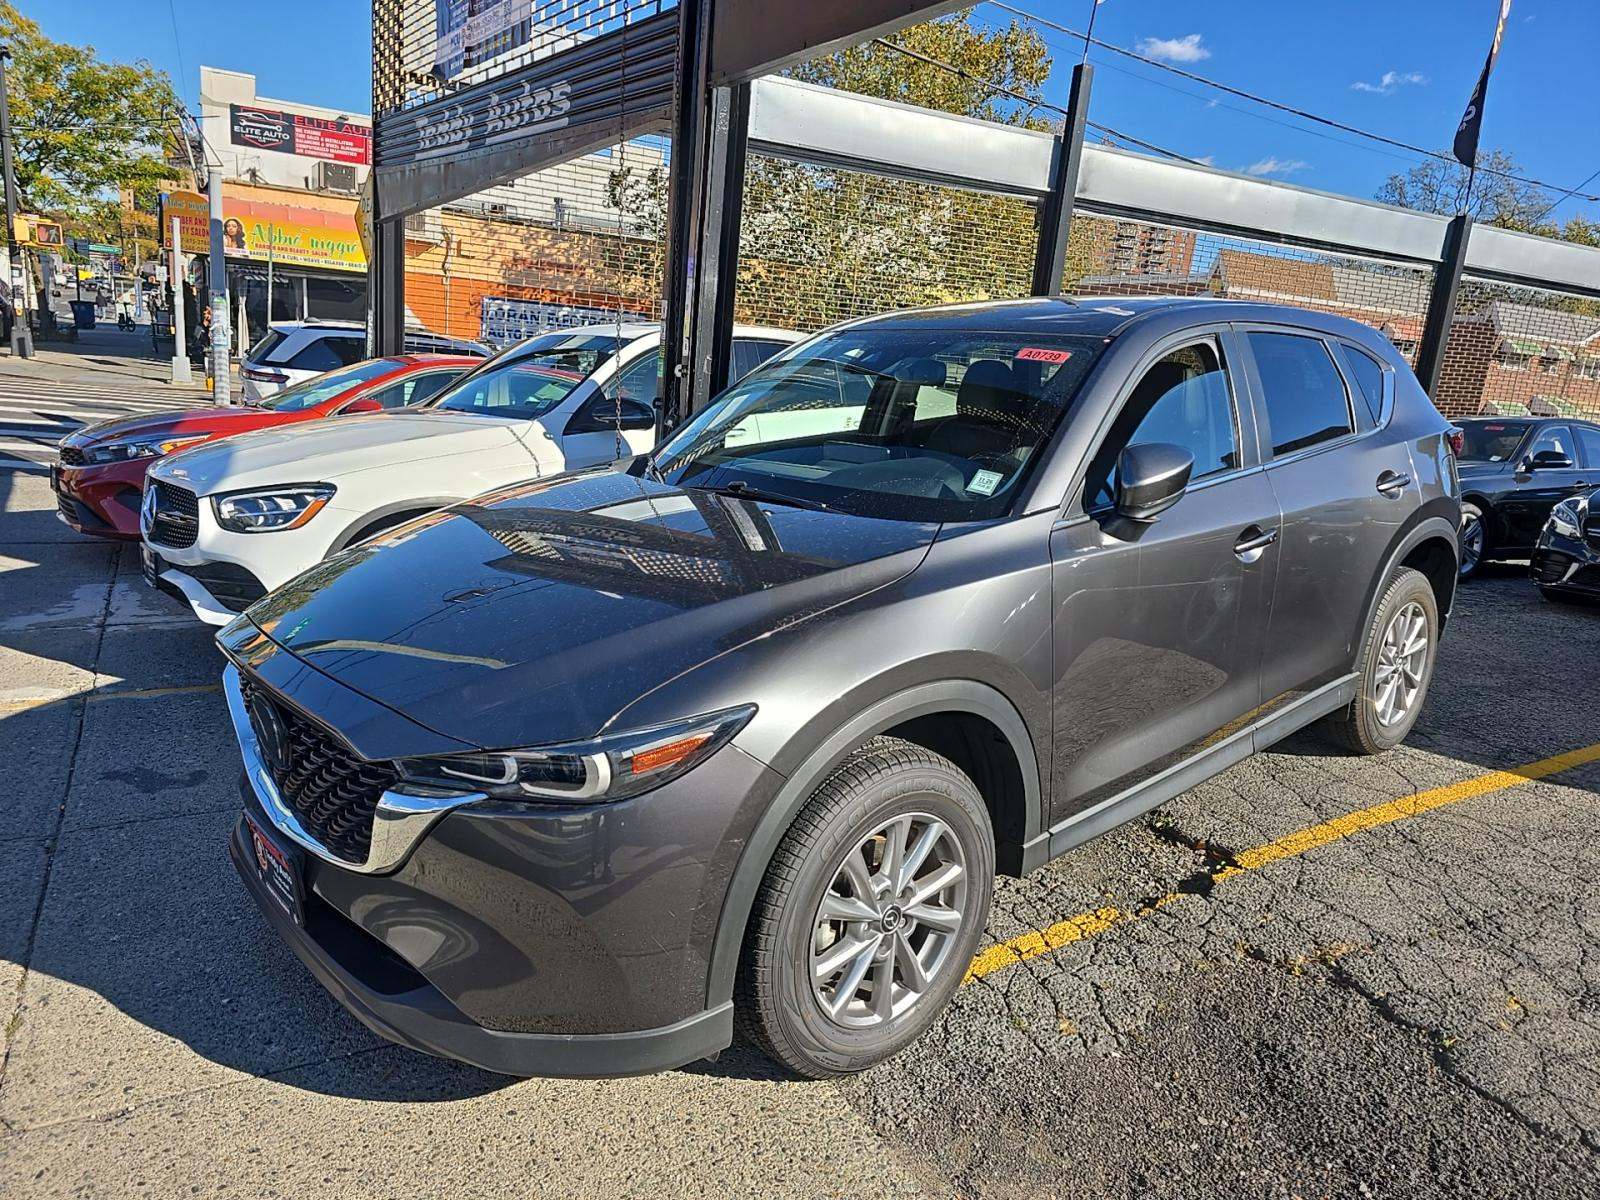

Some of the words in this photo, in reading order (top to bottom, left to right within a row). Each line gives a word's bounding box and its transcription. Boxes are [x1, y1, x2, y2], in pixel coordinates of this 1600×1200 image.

[294, 116, 337, 130] ELITE
[233, 125, 261, 136] ELITE
[262, 130, 290, 140] AUTO
[168, 214, 193, 225] BBER
[194, 217, 208, 227] AND
[166, 224, 190, 235] BETY
[1022, 350, 1062, 361] A0739
